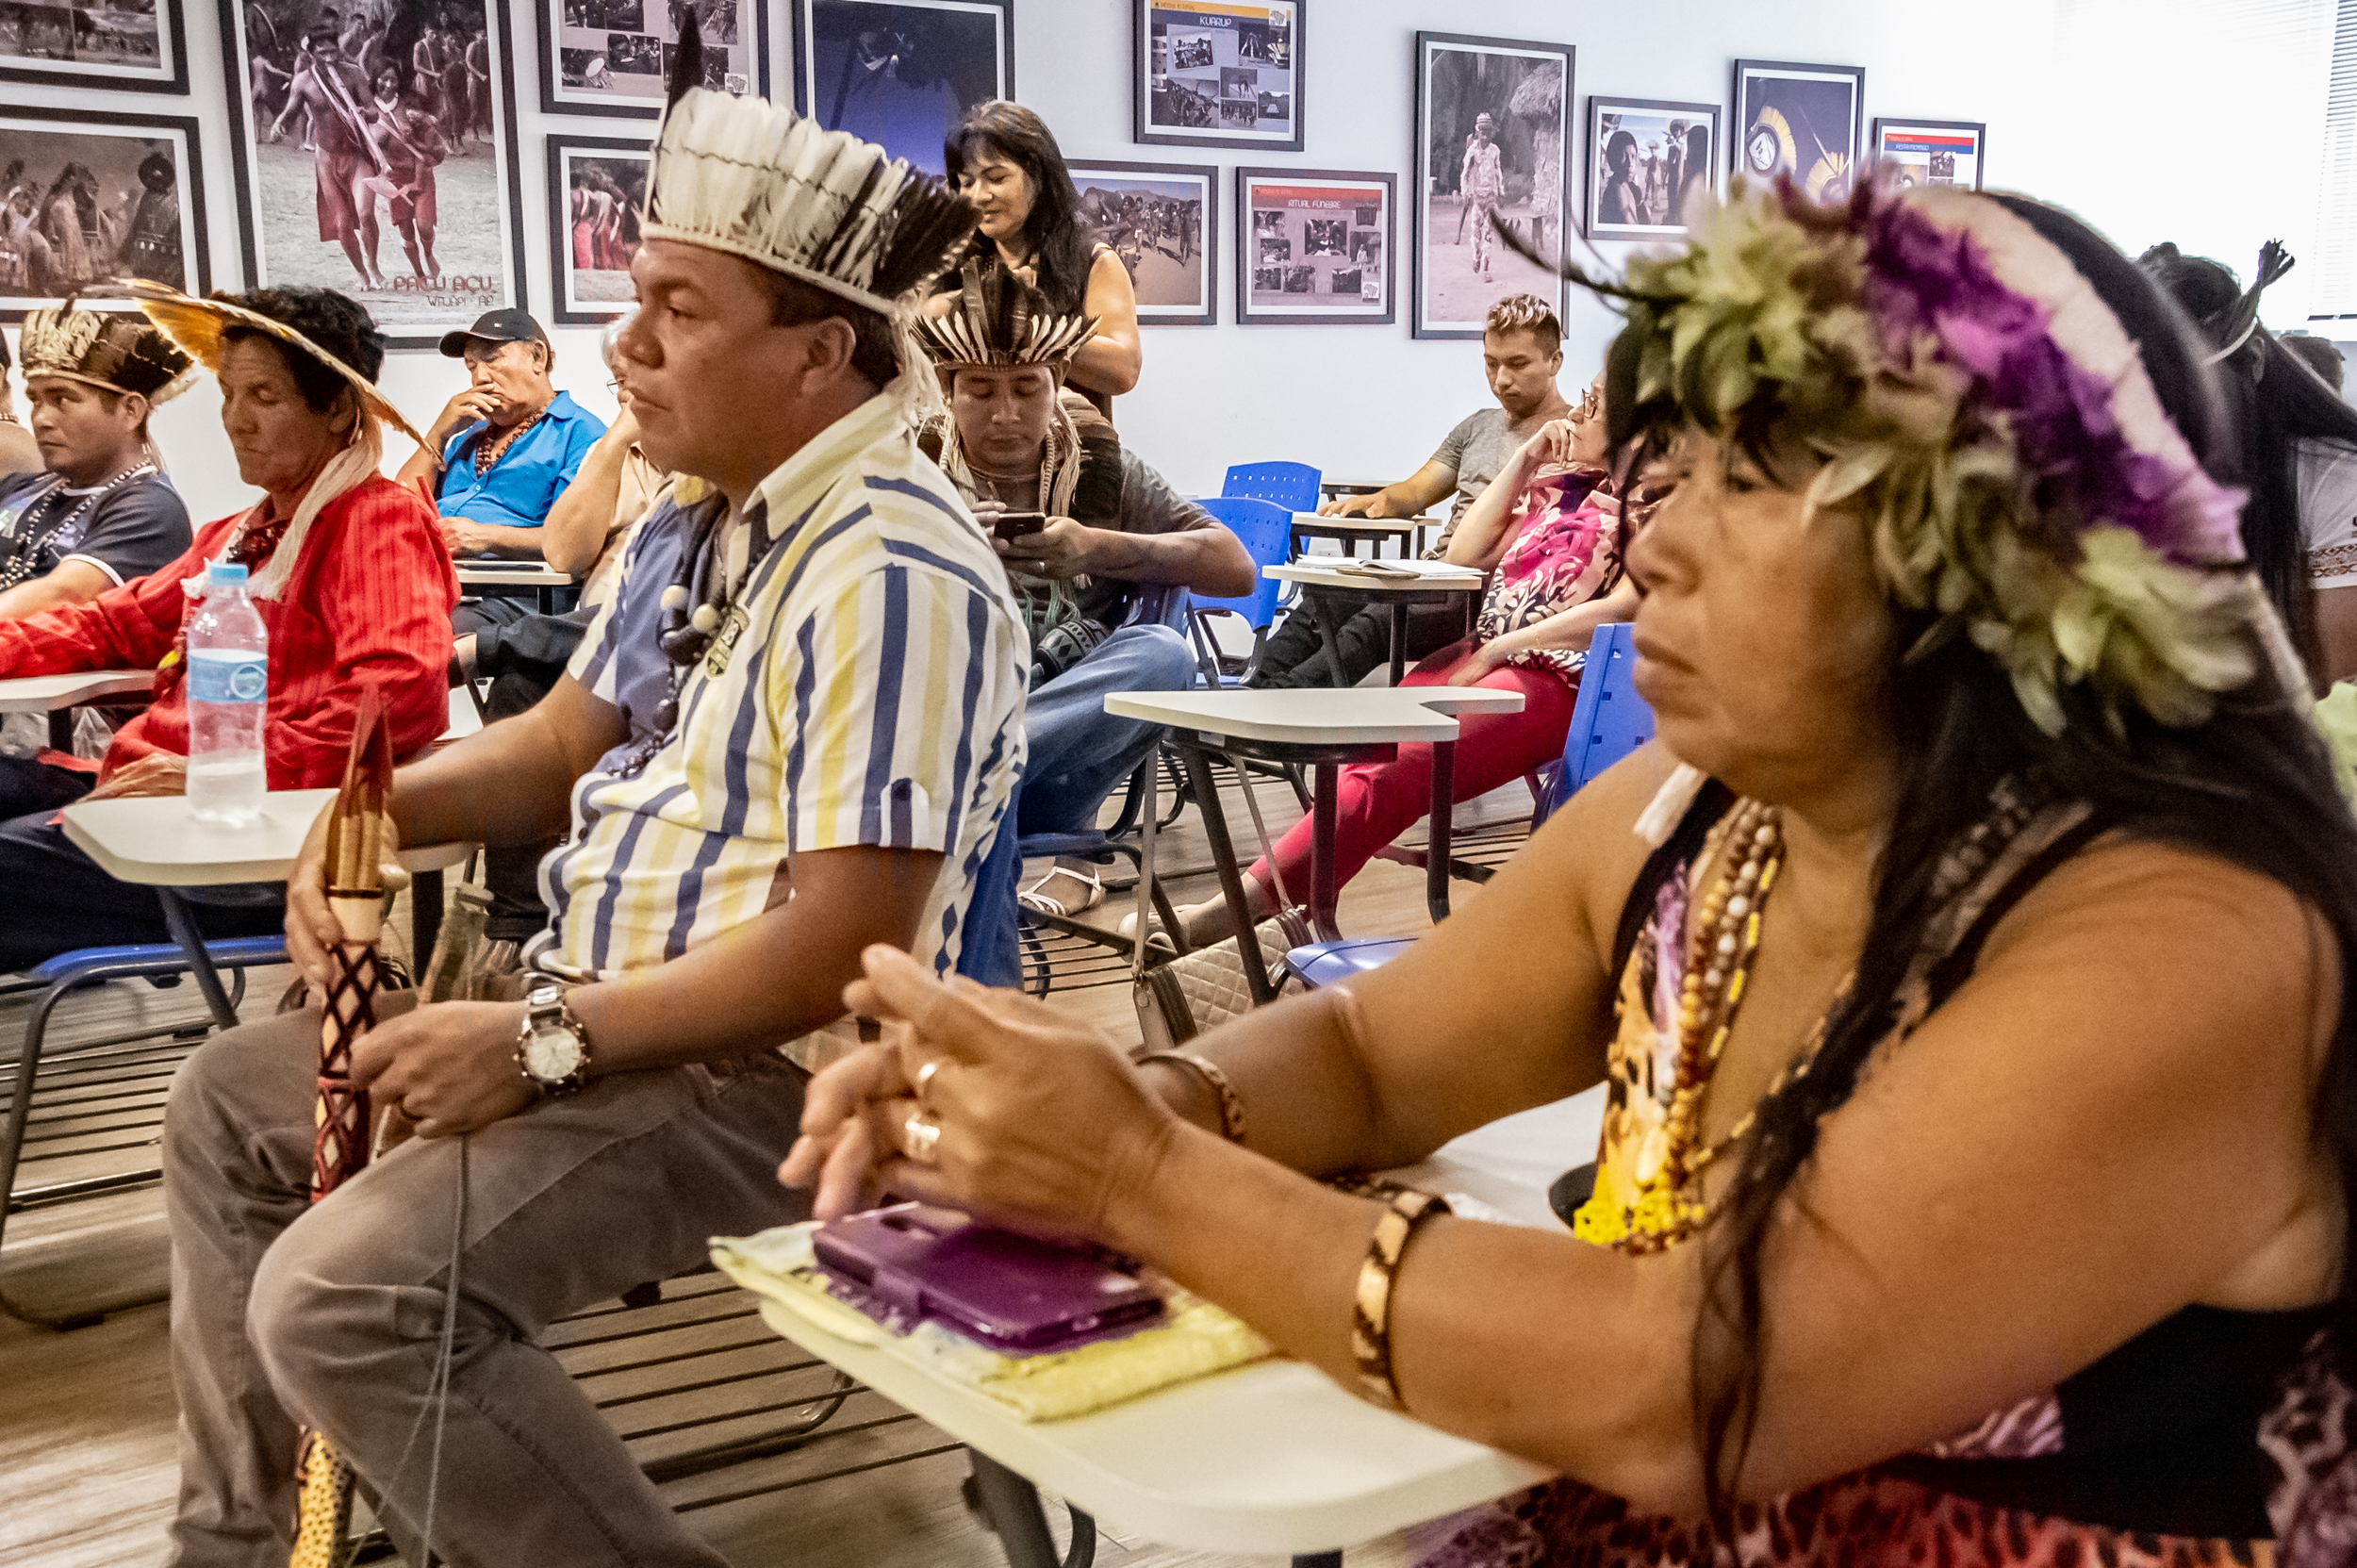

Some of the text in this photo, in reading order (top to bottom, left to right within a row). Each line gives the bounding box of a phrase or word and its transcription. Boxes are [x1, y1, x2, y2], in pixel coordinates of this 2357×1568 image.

[1199, 16, 1232, 27] KUARUP
[1288, 199, 1310, 207] RITUAL
[453, 275, 492, 295] AÇU
